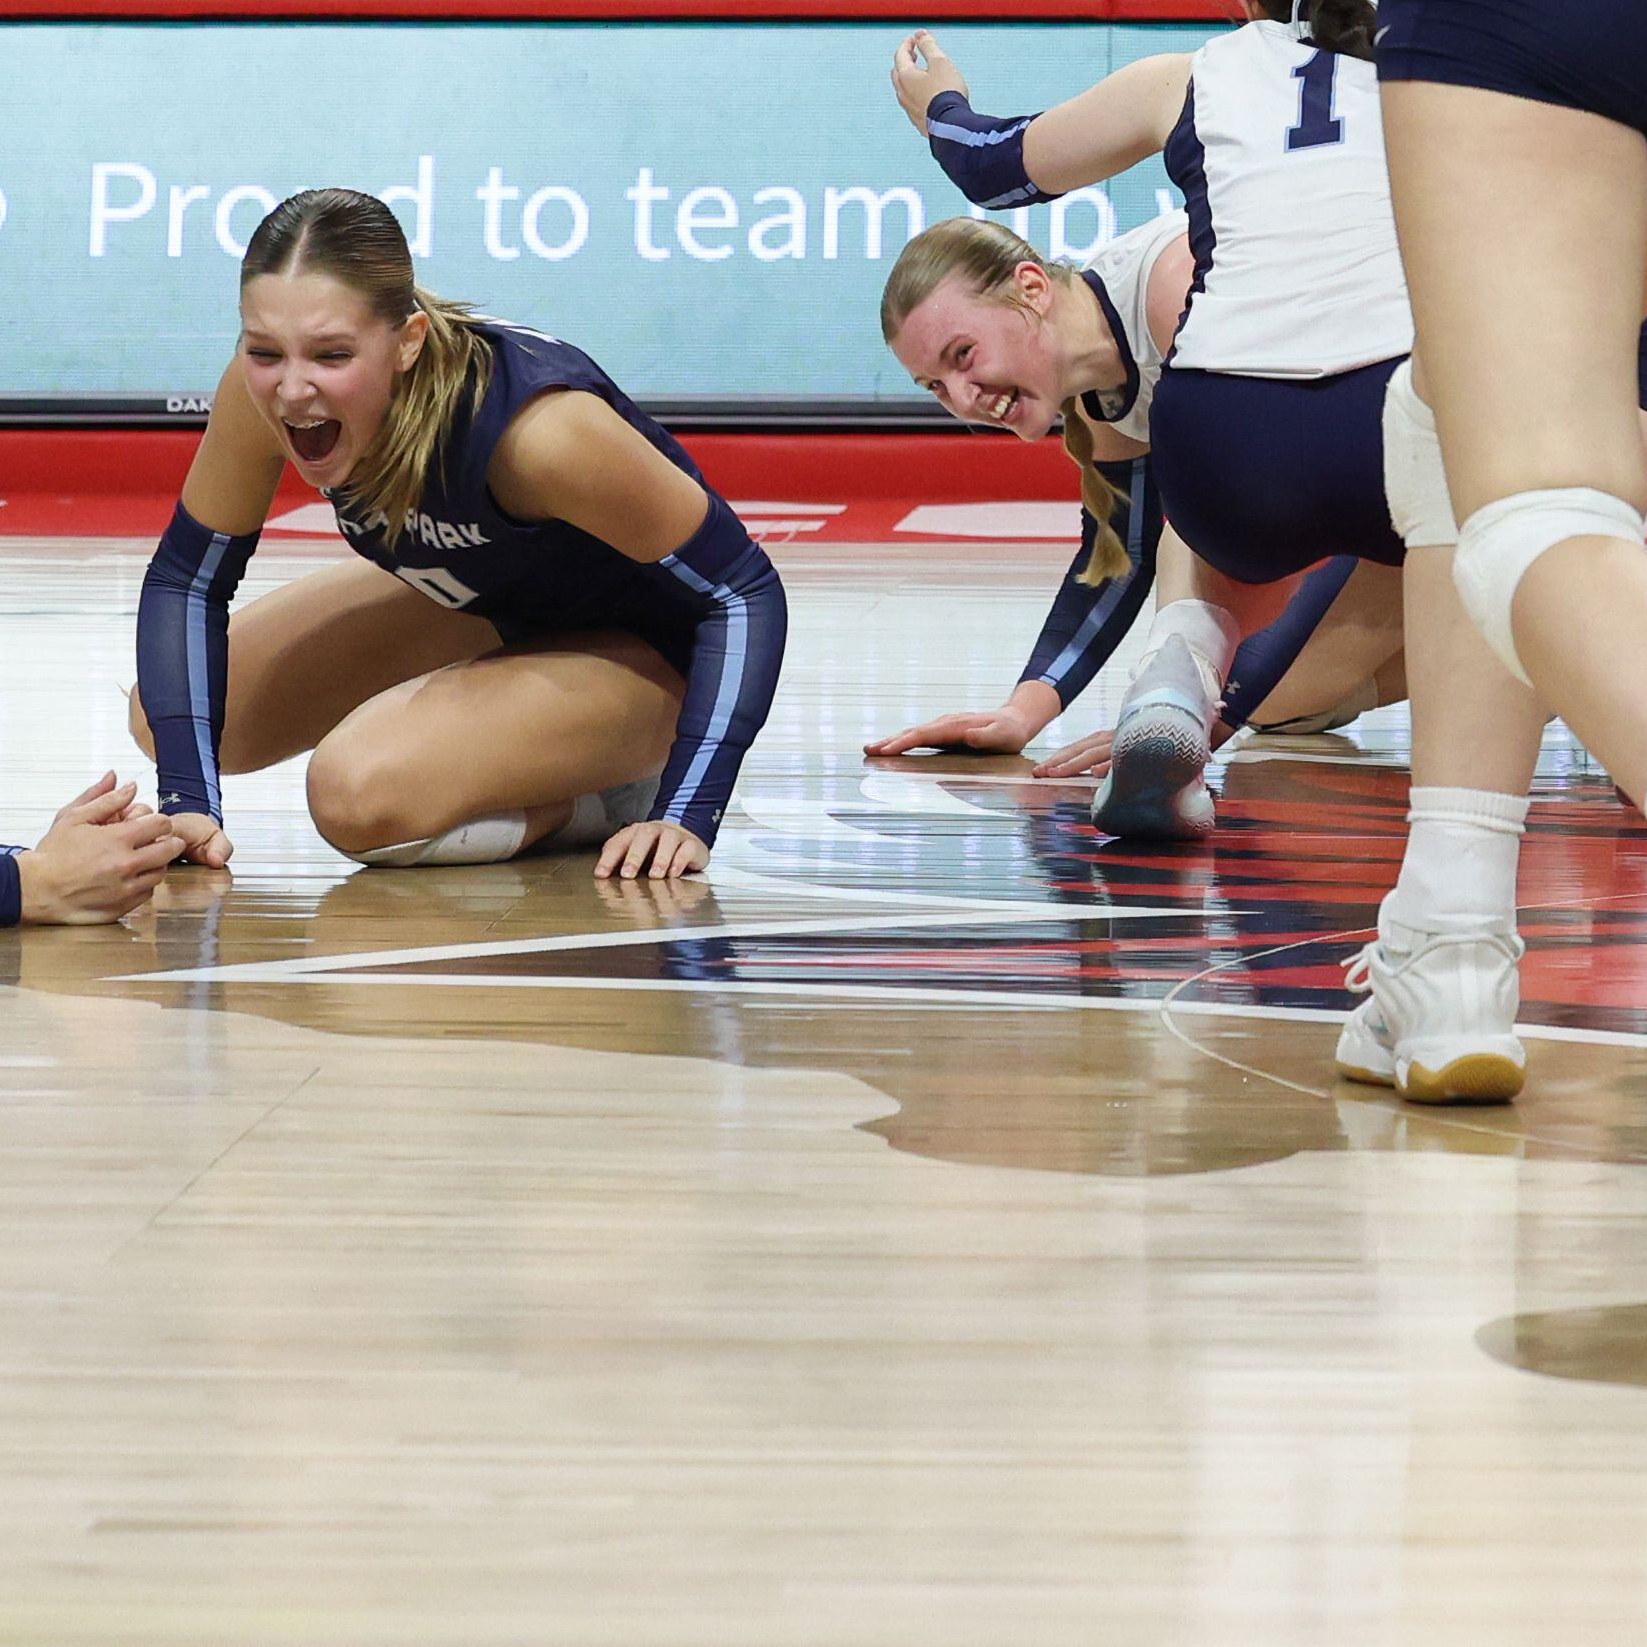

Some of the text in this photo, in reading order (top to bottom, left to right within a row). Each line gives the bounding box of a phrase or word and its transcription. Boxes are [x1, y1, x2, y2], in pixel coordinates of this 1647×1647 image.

[1284, 47, 1346, 154] 1
[89, 154, 437, 263] Prod
[476, 165, 589, 262] to
[627, 165, 925, 262] team
